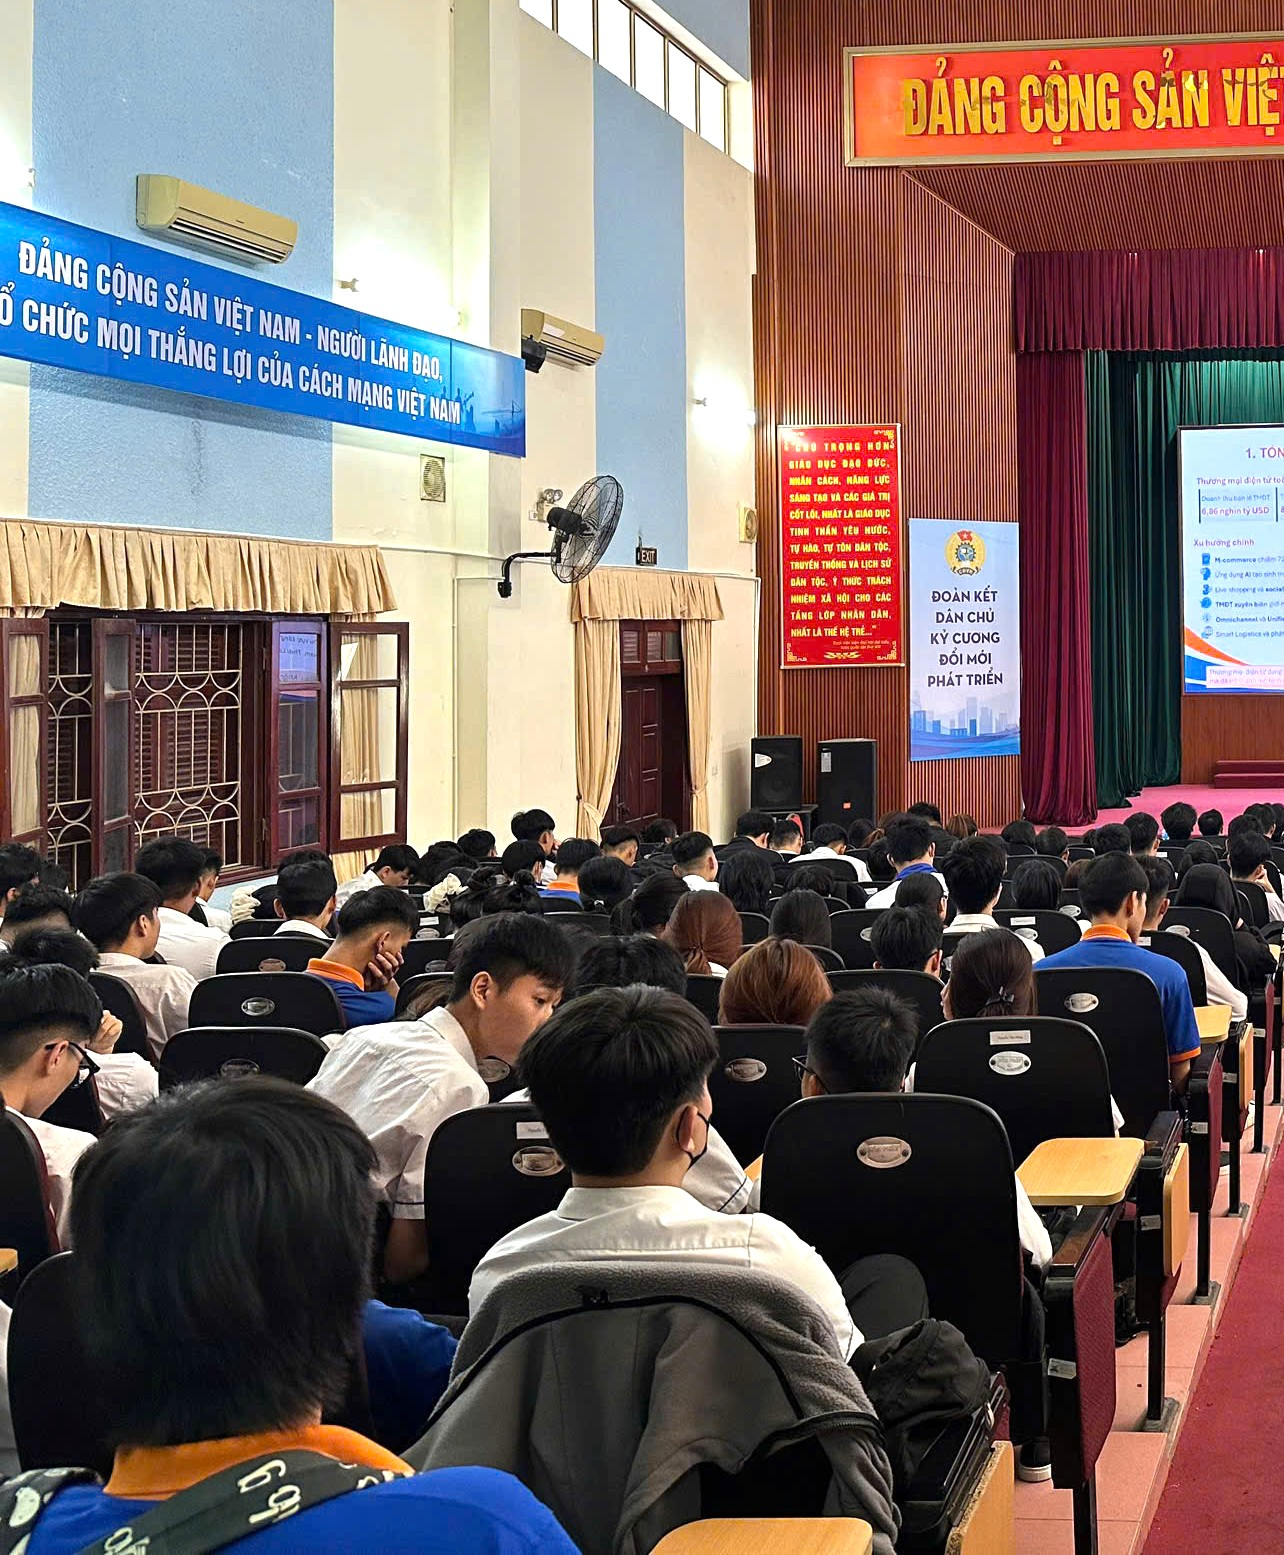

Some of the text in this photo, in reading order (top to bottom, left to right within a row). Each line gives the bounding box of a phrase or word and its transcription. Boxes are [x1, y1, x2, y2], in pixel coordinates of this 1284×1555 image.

[904, 56, 1006, 136] ĐẢNG
[1019, 59, 1120, 145] CỘNG
[1132, 47, 1210, 130] SẢN
[19, 237, 442, 383] ĐẢNG CỘNG SẢN VIỆT NAM NGƯỜI LÃNH ĐẠO,
[22, 298, 89, 345] CHỨC
[97, 317, 141, 359] MỌI
[148, 326, 216, 372] THẮNG
[223, 347, 252, 384] LỢI
[258, 351, 293, 389] CỦA
[299, 363, 343, 399] CÁCH
[347, 377, 393, 411] MẠNG
[397, 388, 426, 421] VIỆT
[430, 392, 461, 425] NAM
[1246, 449, 1256, 459] 1.
[642, 551, 655, 562] EXIT
[855, 594, 870, 602] CHO
[931, 585, 998, 603] ĐOÀN KẾT
[936, 608, 995, 623] DÂN CHỦ
[930, 629, 1000, 644] KỶ CƯƠNG
[939, 647, 992, 666] ĐỔI MỚI
[928, 667, 1003, 687] PHÁT TRIỂN
